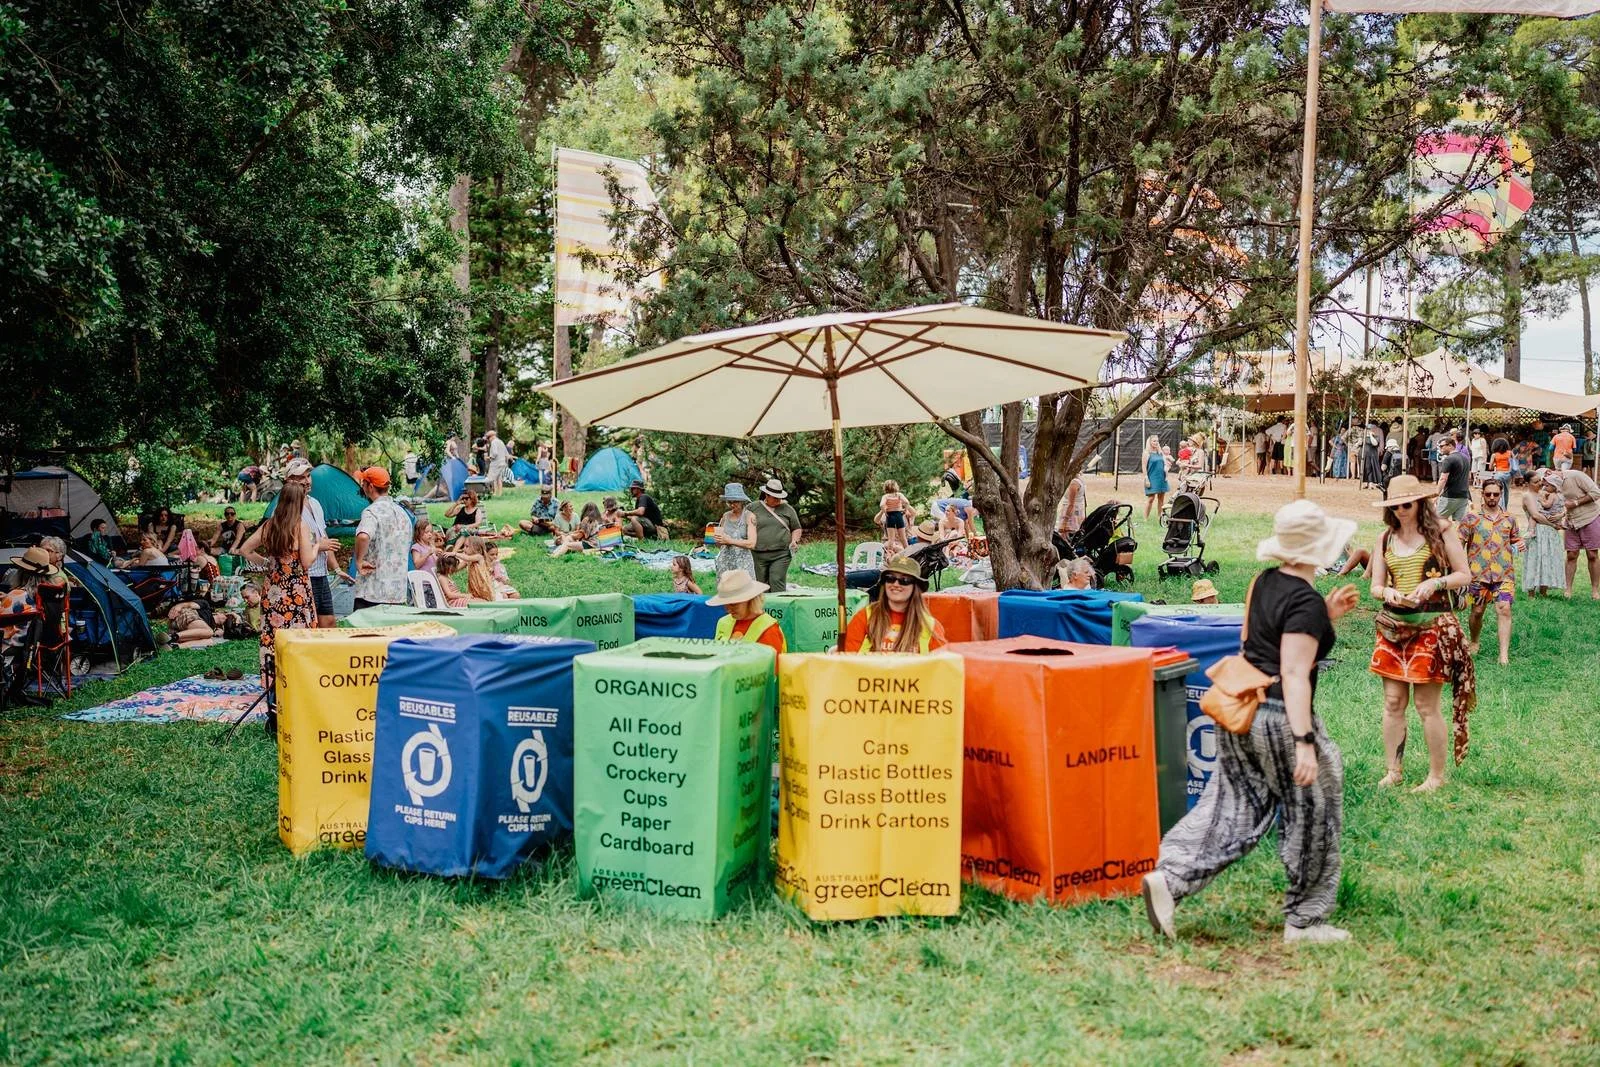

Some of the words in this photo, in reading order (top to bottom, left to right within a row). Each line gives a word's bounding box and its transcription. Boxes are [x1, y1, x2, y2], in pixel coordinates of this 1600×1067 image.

[519, 615, 549, 628] NICS
[576, 612, 623, 628] ORGANICS
[814, 607, 853, 619] ORGACS
[598, 639, 619, 651] Food
[319, 673, 380, 688] CONTA
[594, 678, 698, 700] ORGANICS
[857, 677, 920, 694] DRINK
[400, 700, 457, 719] REUSABLES
[823, 699, 954, 716] CONTAINERS
[507, 710, 559, 724] REUSABLES
[609, 716, 632, 734] All
[638, 718, 682, 737] Food
[318, 728, 375, 744] Plastic
[323, 749, 372, 764] Glass
[613, 741, 679, 764] Cutlery
[862, 739, 910, 756] Cans
[1065, 744, 1141, 769] LANDFILL
[963, 746, 1015, 769] ANDFILL
[321, 769, 368, 785] Drink
[606, 763, 687, 789] Crockery
[818, 763, 882, 781] Plastic
[886, 763, 954, 781] Bottles
[623, 788, 669, 810] Cups
[823, 788, 877, 806] Glass
[880, 788, 948, 806] Bottles
[395, 804, 423, 818] PLEASE
[424, 807, 457, 823] RETURN
[404, 815, 423, 827] CUPS
[424, 817, 447, 830] HERE
[498, 813, 529, 825] PLEASE
[530, 813, 552, 824] RETURN
[620, 811, 672, 832] Paper
[819, 813, 872, 830] Drink
[876, 812, 950, 830] Cartons
[507, 823, 529, 833] CUPS
[600, 832, 695, 857] Cardboard
[593, 867, 645, 880] ADELAIDE
[960, 853, 1041, 888] reenClean
[1053, 856, 1157, 896] greenClean
[592, 874, 703, 900] greenClean
[814, 876, 951, 904] greenClean
